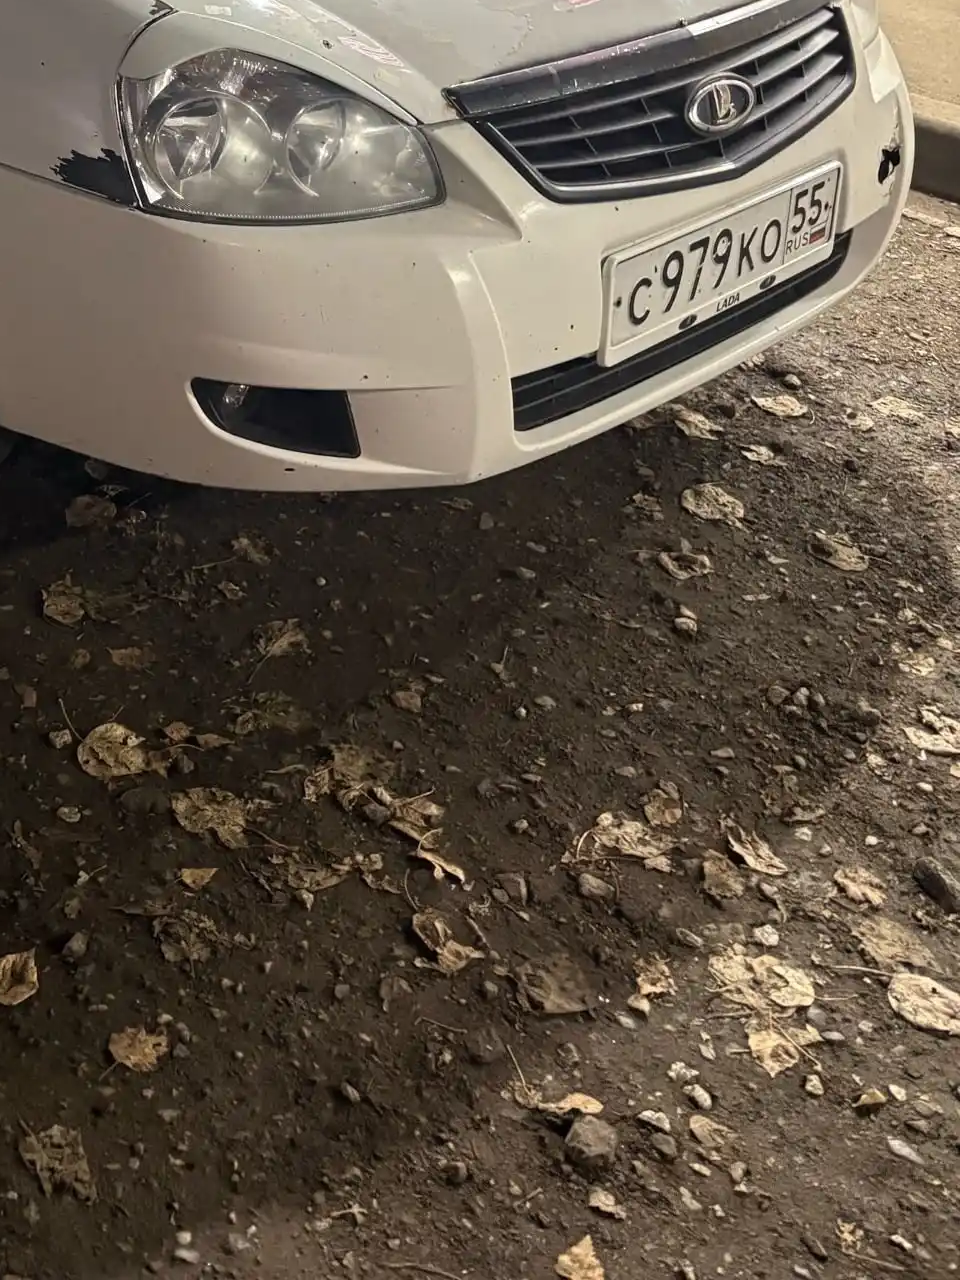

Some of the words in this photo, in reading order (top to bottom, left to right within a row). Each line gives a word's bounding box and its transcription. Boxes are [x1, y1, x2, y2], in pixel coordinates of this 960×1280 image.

[792, 182, 826, 233] 55
[786, 231, 809, 256] RUS
[716, 292, 741, 312] LADA
